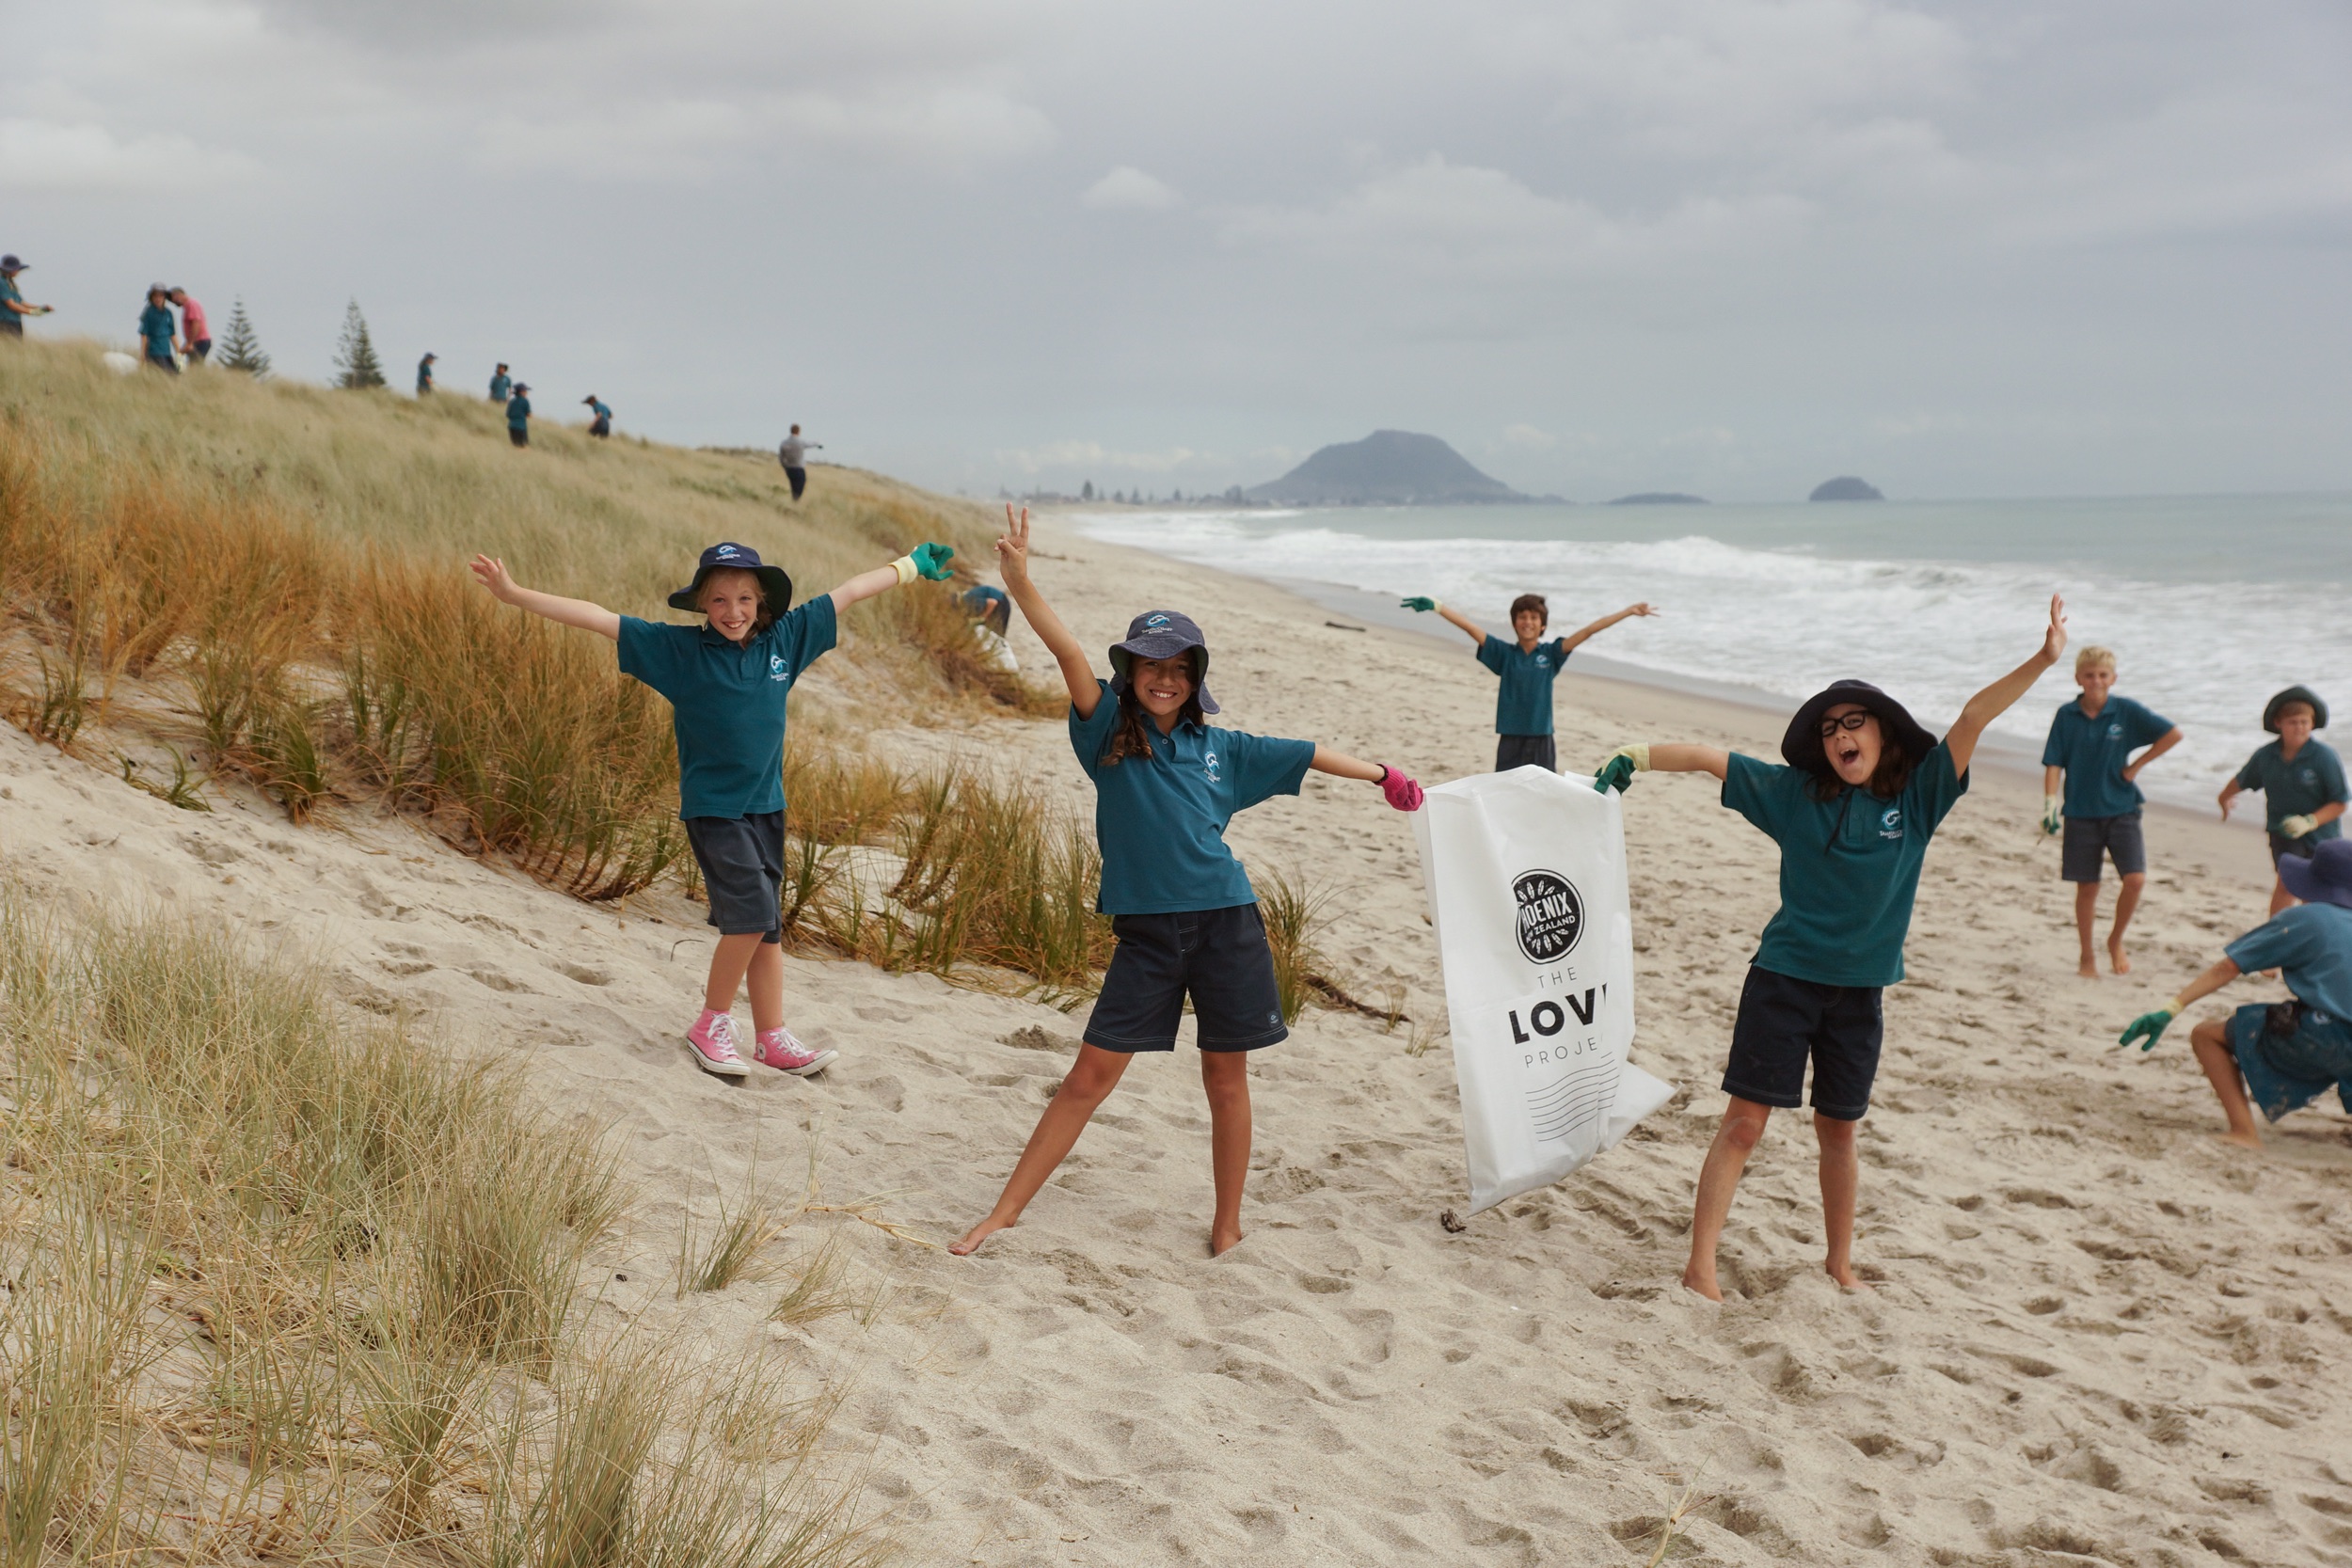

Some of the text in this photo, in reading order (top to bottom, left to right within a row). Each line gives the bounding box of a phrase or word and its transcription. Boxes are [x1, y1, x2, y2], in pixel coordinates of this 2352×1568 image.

[1519, 891, 1572, 934] HOENIX
[1534, 915, 1576, 936] ZEALAND
[1537, 966, 1578, 989] THE
[1508, 982, 1608, 1045] LOV
[1524, 1033, 1603, 1069] PROJE
